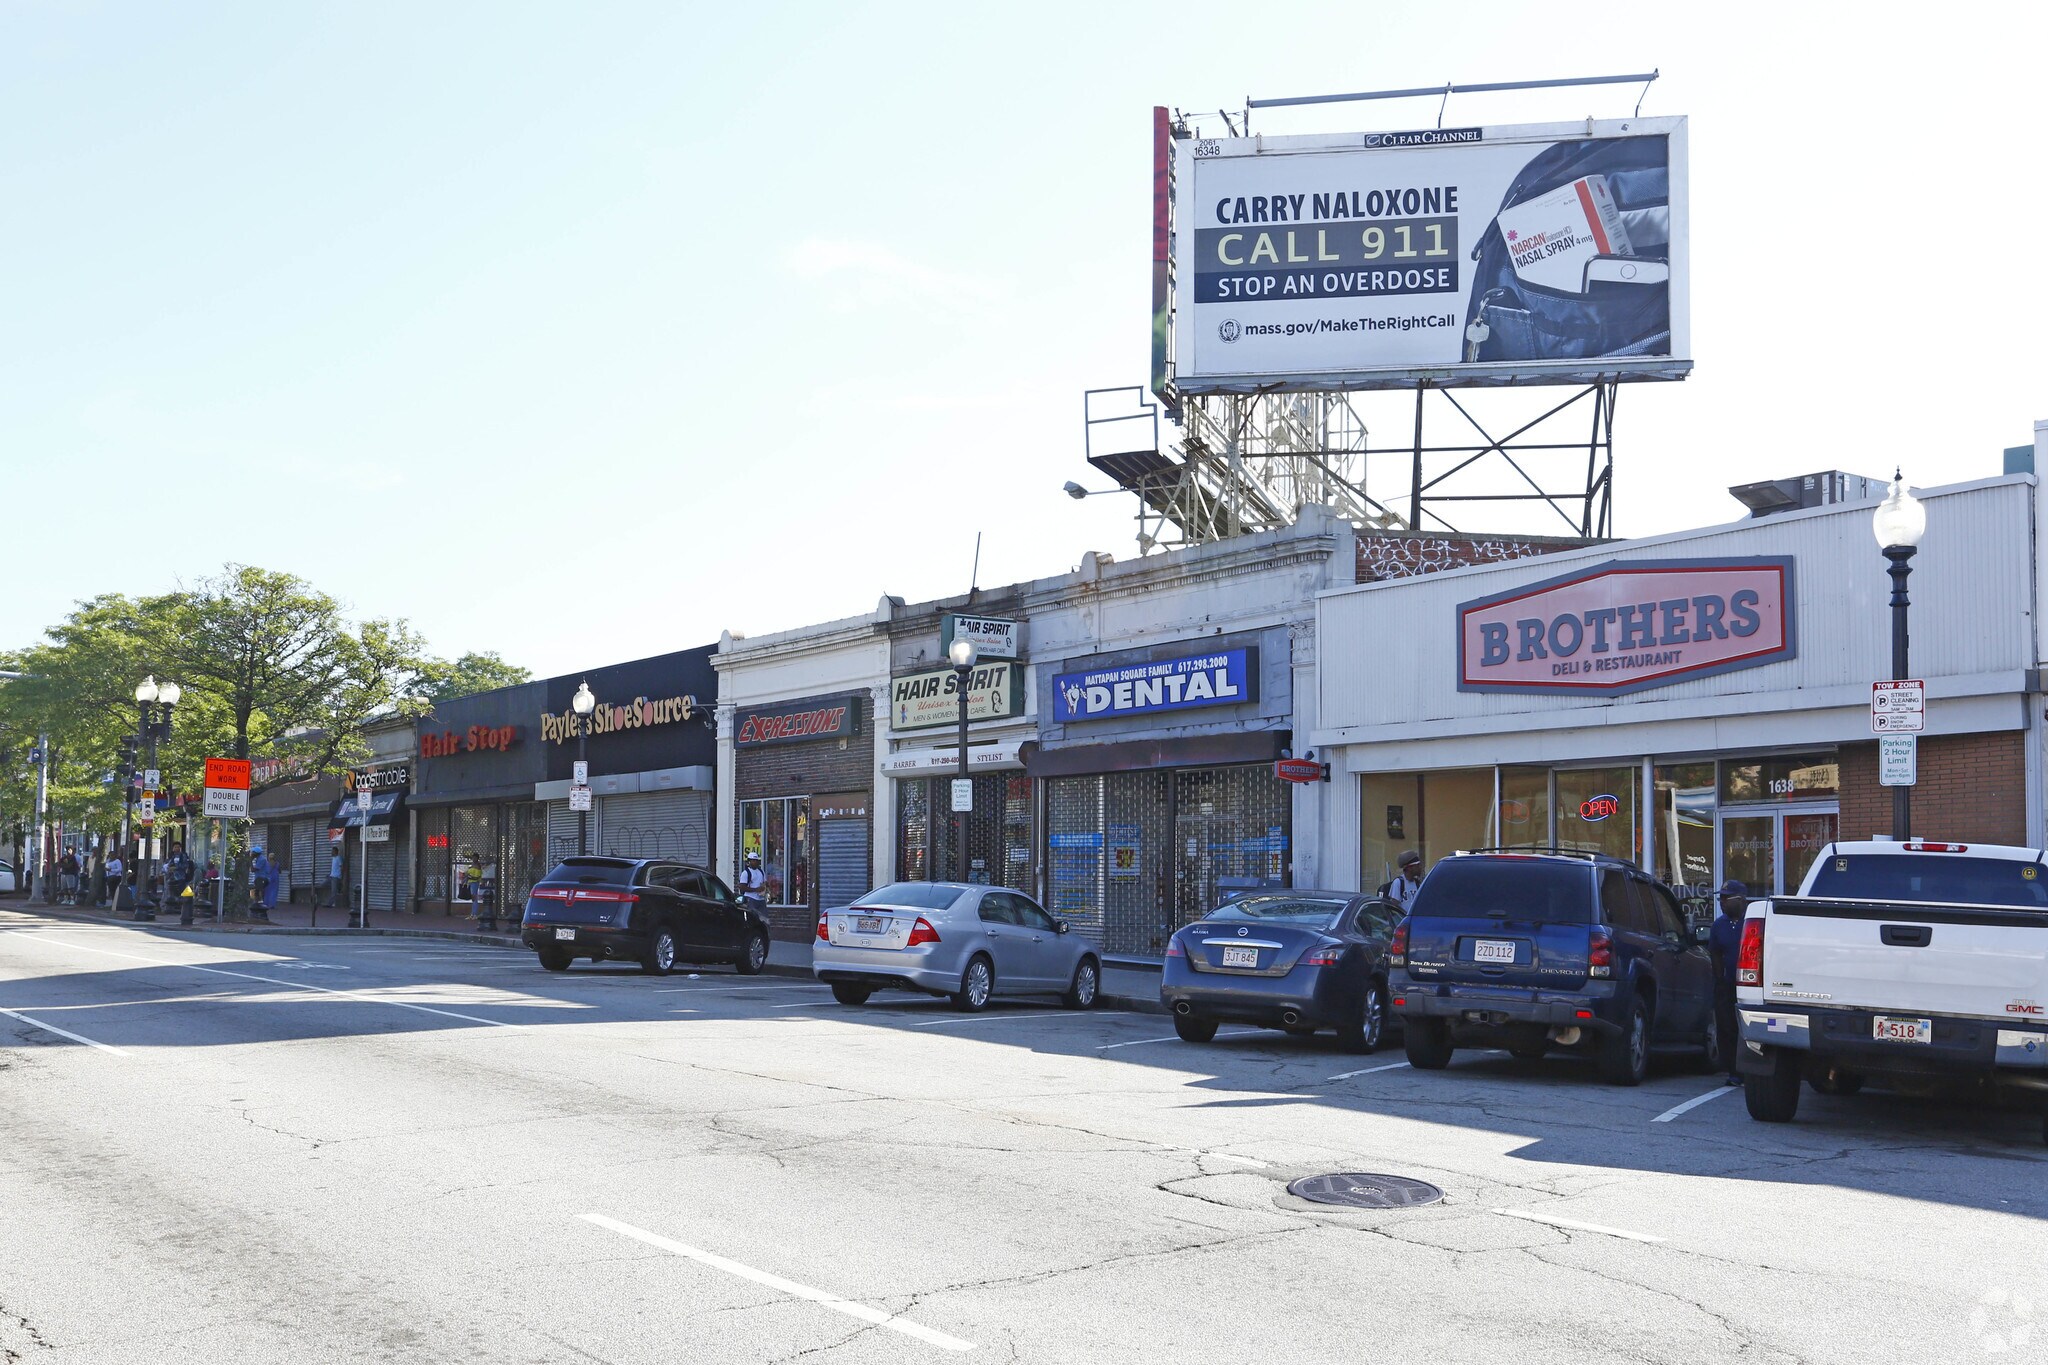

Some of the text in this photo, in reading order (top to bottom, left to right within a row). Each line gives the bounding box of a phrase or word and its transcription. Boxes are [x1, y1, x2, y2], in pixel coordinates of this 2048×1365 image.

[1194, 146, 1221, 157] 16348
[1216, 186, 1459, 224] CARRY NALOXONE
[1217, 224, 1449, 266] CALL 911
[1510, 232, 1546, 257] NARCAN
[1515, 248, 1546, 269] NASAL
[1545, 234, 1576, 257] SPRAY
[1580, 234, 1594, 244] mg
[1218, 268, 1450, 297] STOP AN OVERDOSE
[1245, 314, 1455, 336] mass.gov/MakeTheRightCall
[982, 622, 1011, 636] SPIRIT
[1480, 589, 1761, 667] BROTHERS
[1085, 655, 1228, 686] MATTAPAN SQUARE FAMILY 617.298.2000
[1552, 650, 1683, 676] DELI & RESTAURANT
[895, 677, 940, 702] HAIR
[1086, 668, 1238, 714] DENTAL
[595, 695, 693, 734] ShoeSource
[932, 711, 955, 720] WOMEN
[970, 706, 987, 715] CARE
[738, 707, 847, 743] EXPRESSIONS
[420, 725, 515, 759] Hair Stop
[1883, 740, 1912, 748] Parking
[209, 763, 247, 773] END ROAD
[893, 760, 917, 769] BARBER
[977, 753, 1003, 762] STYLIST
[1281, 765, 1318, 774] BROTHERS
[218, 776, 237, 784] WORK
[1768, 779, 1794, 794] 1638
[212, 791, 240, 801] DOUBLE
[207, 803, 245, 812] FINES END
[1579, 799, 1617, 817] OPEN
[1225, 952, 1255, 963] 3JT 845
[1496, 946, 1513, 958] 112
[1540, 968, 1586, 976] CHEVROLET
[1772, 990, 1832, 1000] SIERRA
[2006, 1004, 2044, 1014] GMC
[1890, 1023, 1915, 1038] 518
